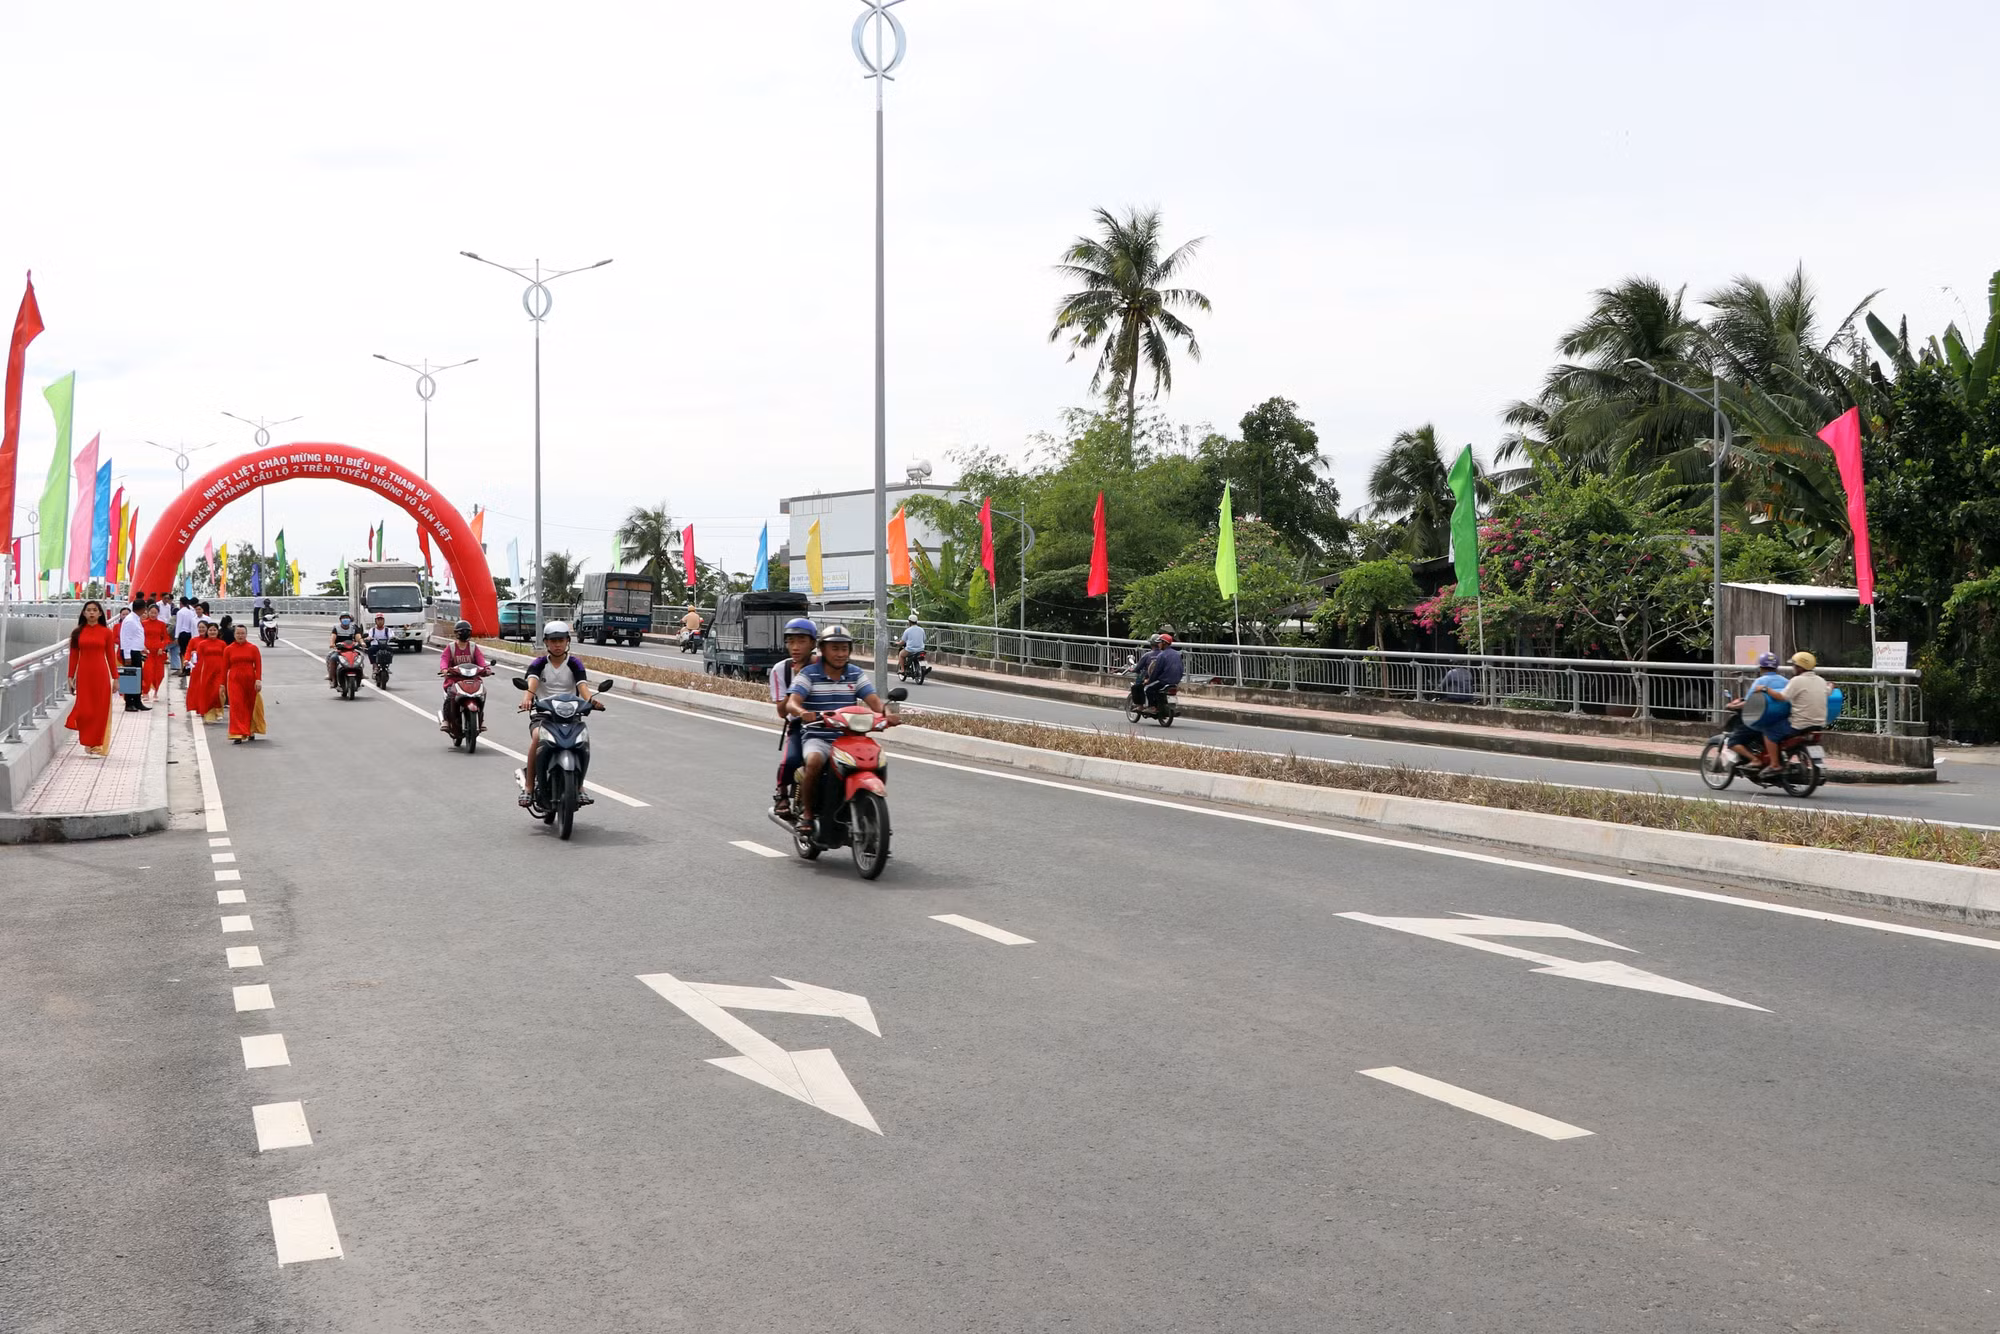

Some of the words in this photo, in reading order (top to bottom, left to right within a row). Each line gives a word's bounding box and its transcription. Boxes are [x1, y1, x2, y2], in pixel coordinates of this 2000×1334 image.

[188, 501, 218, 530] KHÁNH
[217, 480, 250, 501] THÀNH
[302, 463, 330, 472] TRÊN
[418, 504, 435, 522] VĂN
[434, 521, 452, 542] KIỆT
[203, 476, 232, 500] NHIỆT
[232, 464, 255, 480] LIỆT
[258, 456, 287, 470] CHÀO
[290, 452, 320, 463] MỪNG
[325, 454, 343, 464] ĐẠI
[346, 457, 371, 470] BIỂU
[389, 472, 416, 492] THAM
[416, 488, 432, 502] DỰ
